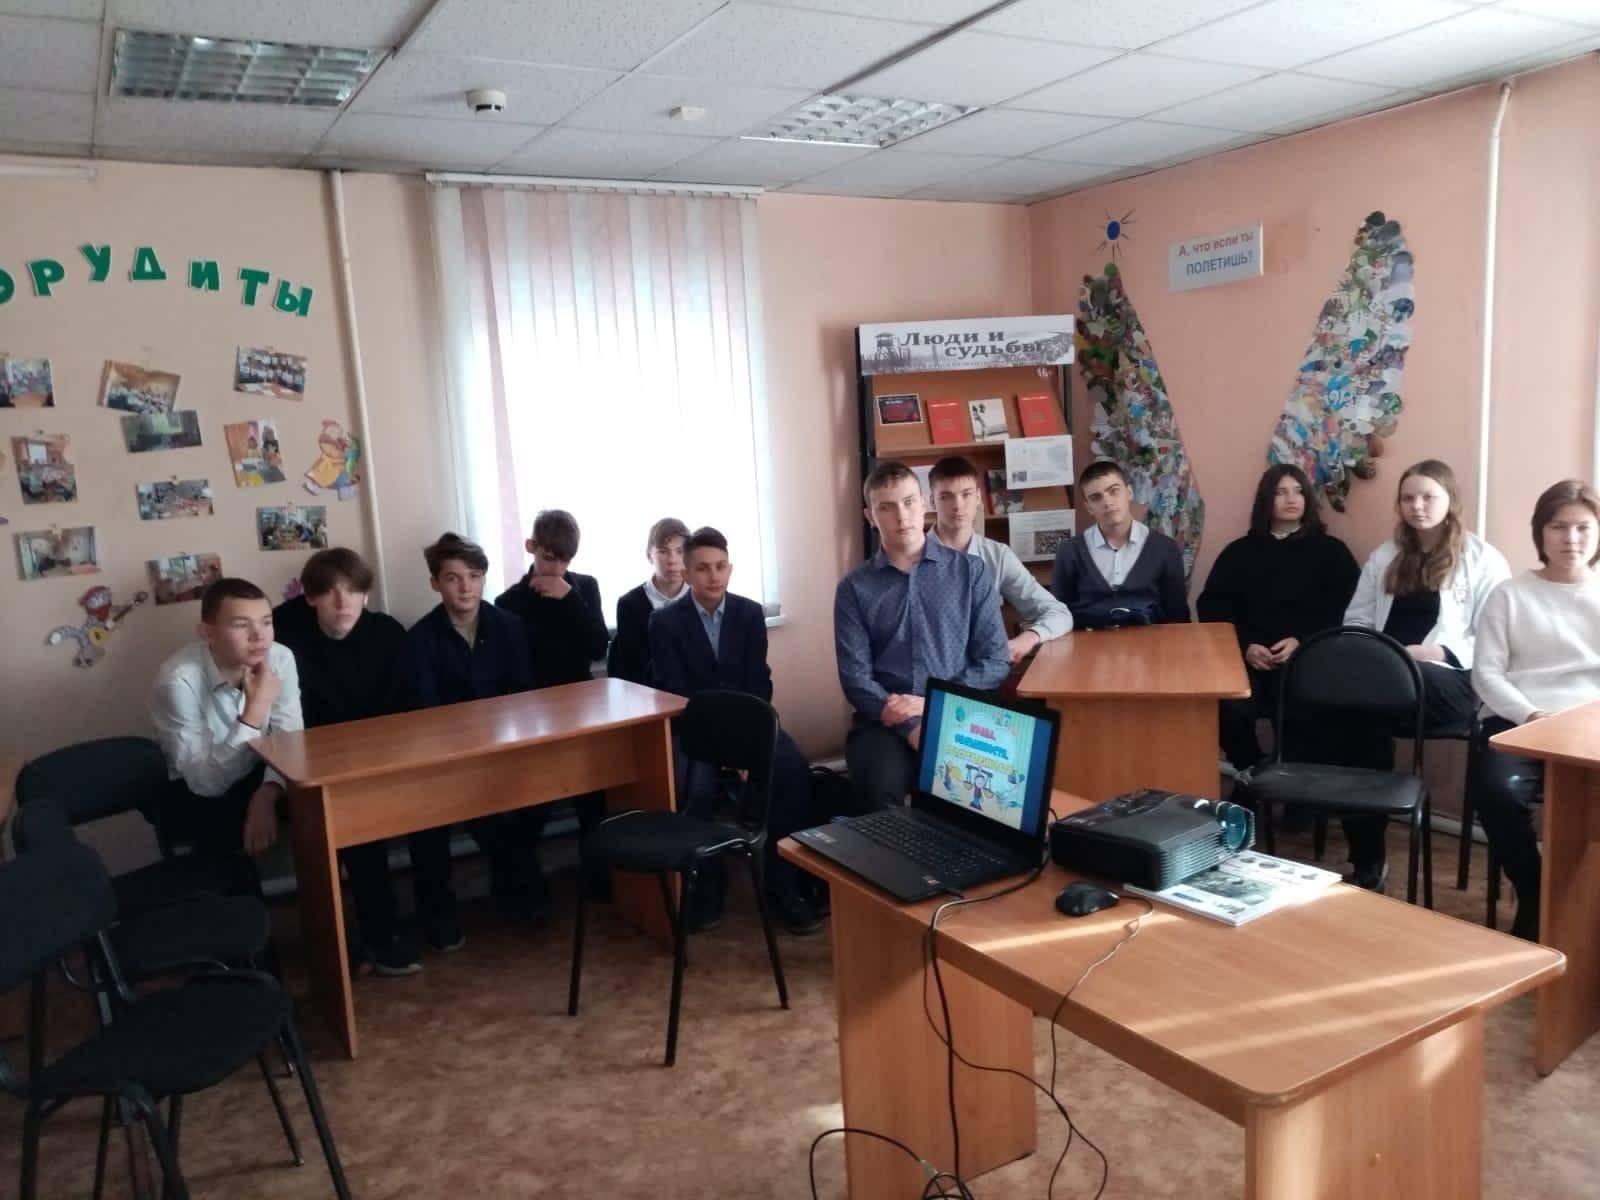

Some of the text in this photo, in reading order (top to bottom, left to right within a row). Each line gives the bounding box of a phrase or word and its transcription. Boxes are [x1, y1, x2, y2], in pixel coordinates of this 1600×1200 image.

[1192, 242, 1211, 254] что
[1214, 233, 1239, 250] если
[1241, 231, 1254, 242] ты
[901, 331, 1004, 347] Люди и
[945, 340, 1048, 360] судьбы
